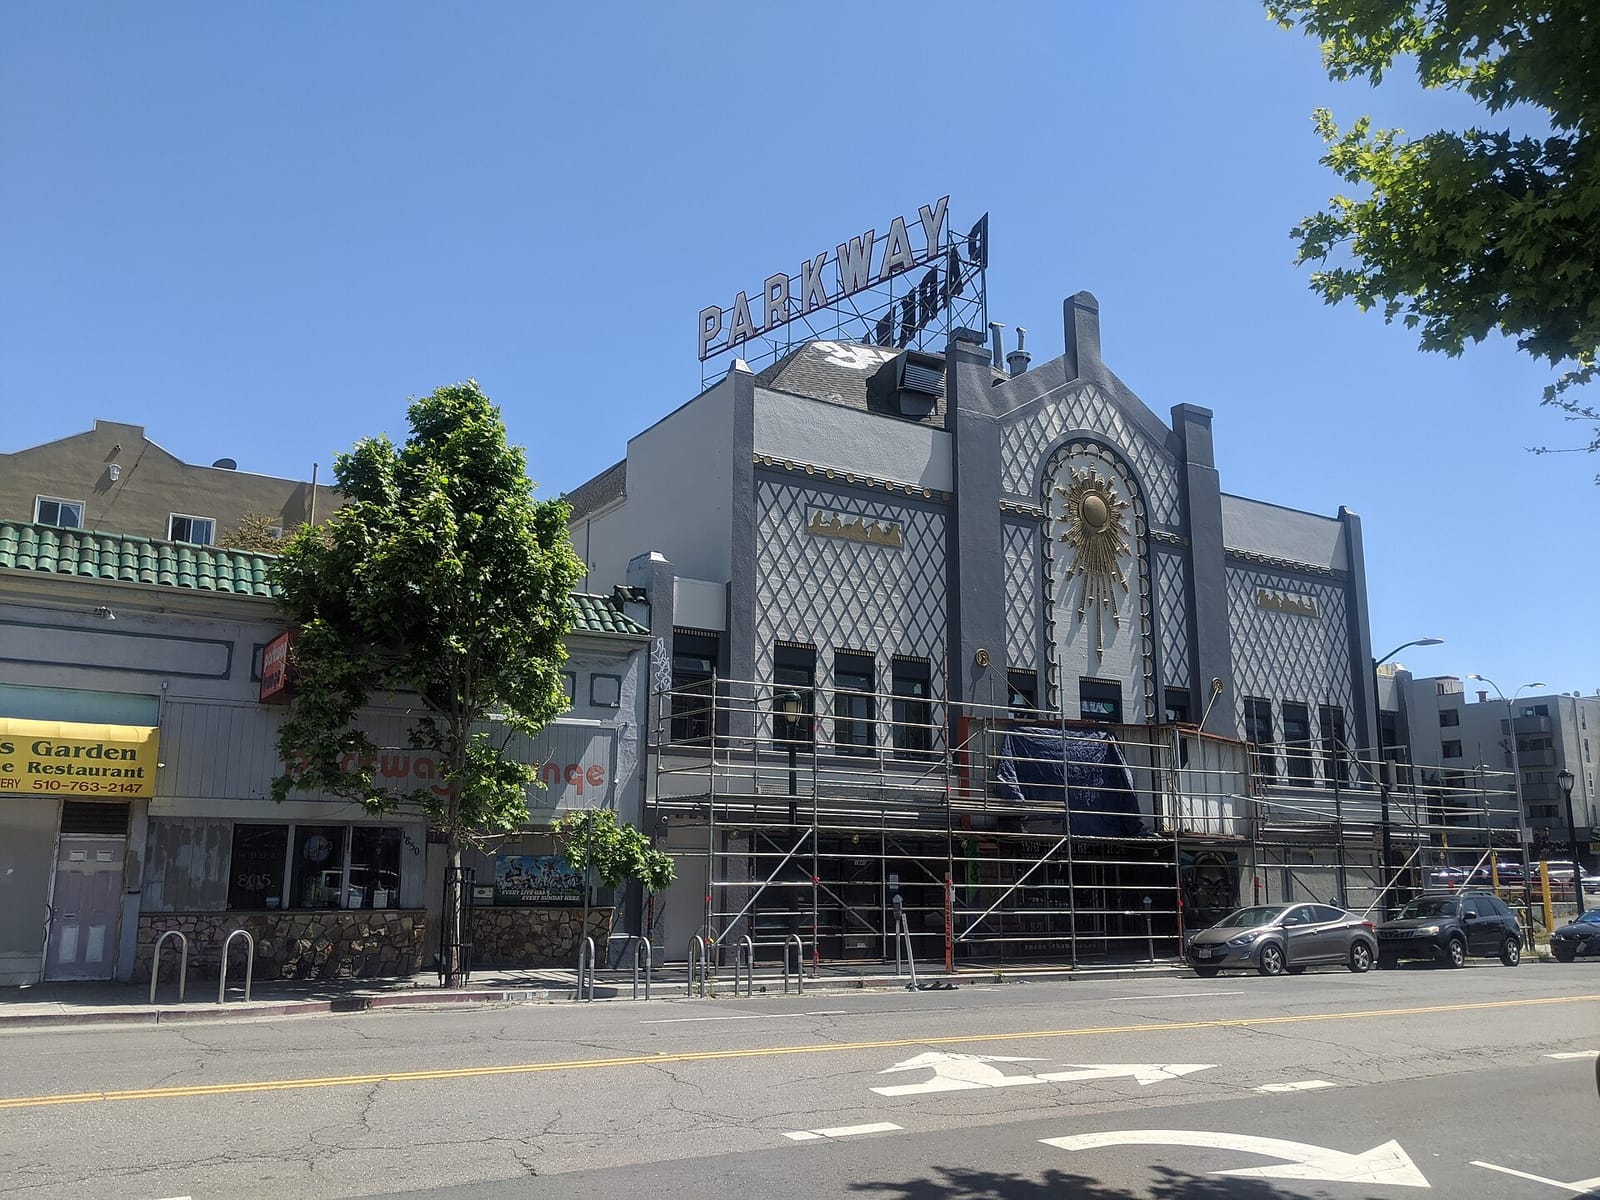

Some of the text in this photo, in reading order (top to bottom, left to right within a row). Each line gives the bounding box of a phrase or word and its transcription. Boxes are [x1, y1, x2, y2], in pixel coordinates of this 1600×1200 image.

[698, 195, 950, 361] PARKWAY
[31, 740, 137, 761] Garden
[27, 761, 145, 779] Restaurant
[0, 777, 143, 794] ERY 510-763-2147
